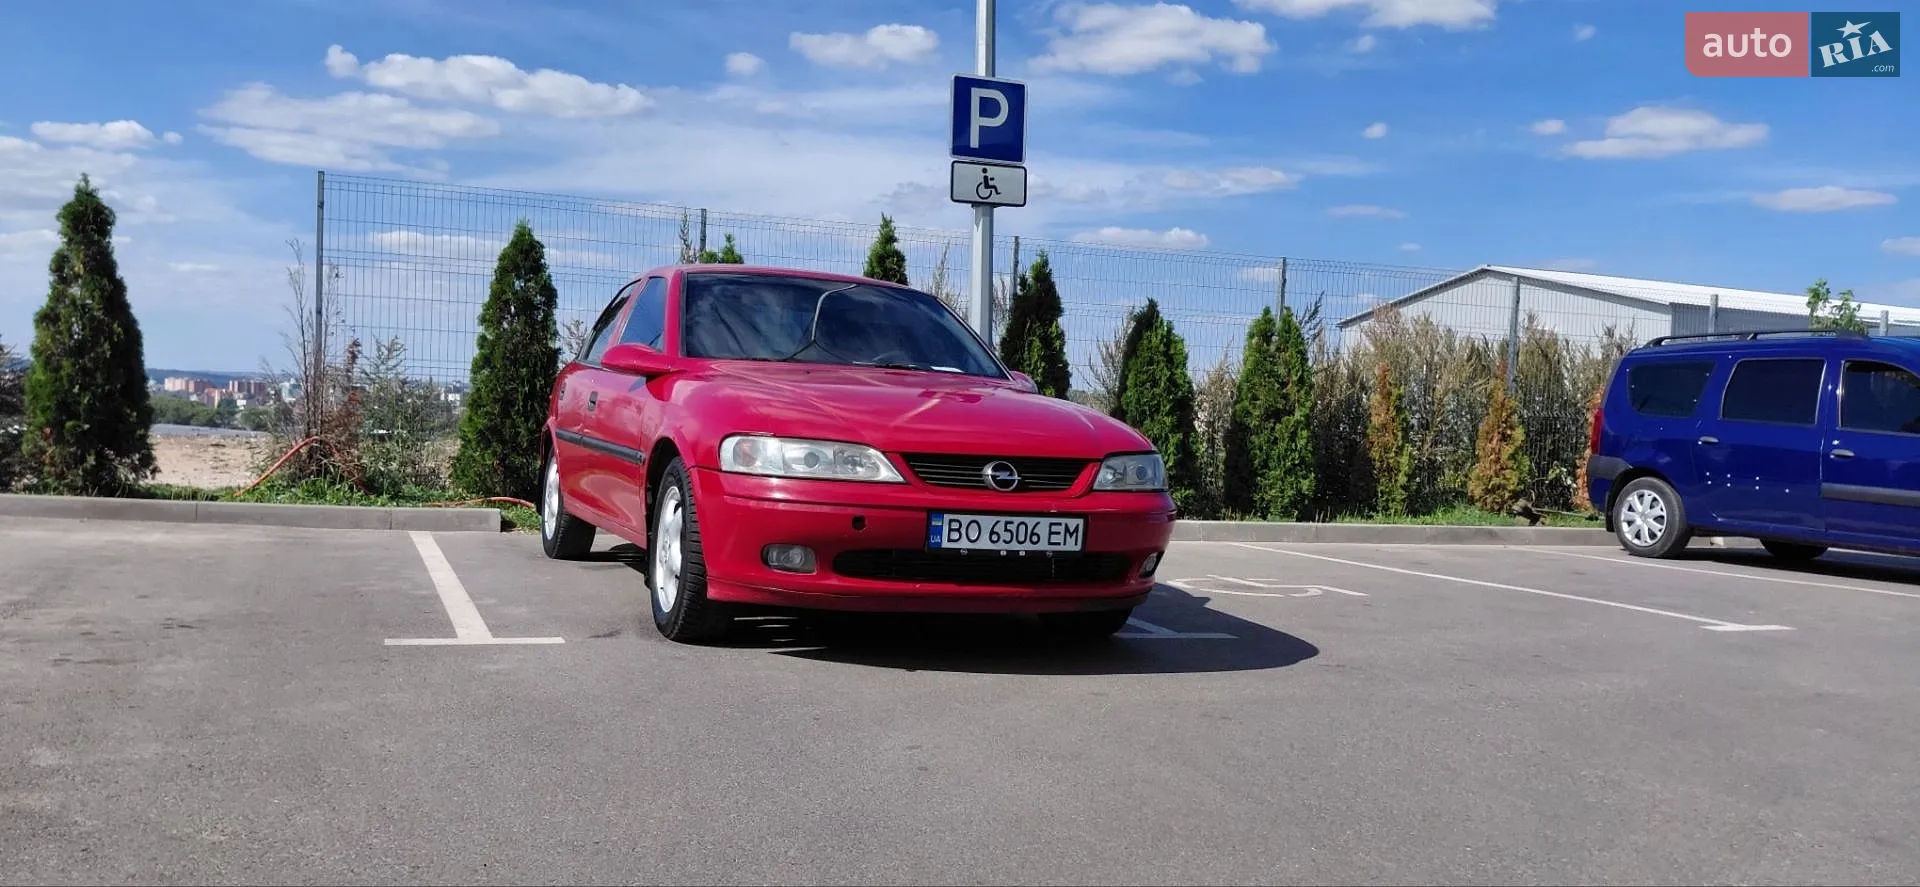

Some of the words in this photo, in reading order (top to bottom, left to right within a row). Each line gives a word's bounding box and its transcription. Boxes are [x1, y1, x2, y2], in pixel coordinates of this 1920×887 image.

[970, 87, 1009, 149] P
[930, 535, 941, 543] UA
[947, 518, 982, 544] BO
[988, 520, 1041, 546] 6506
[1047, 522, 1080, 547] EM
